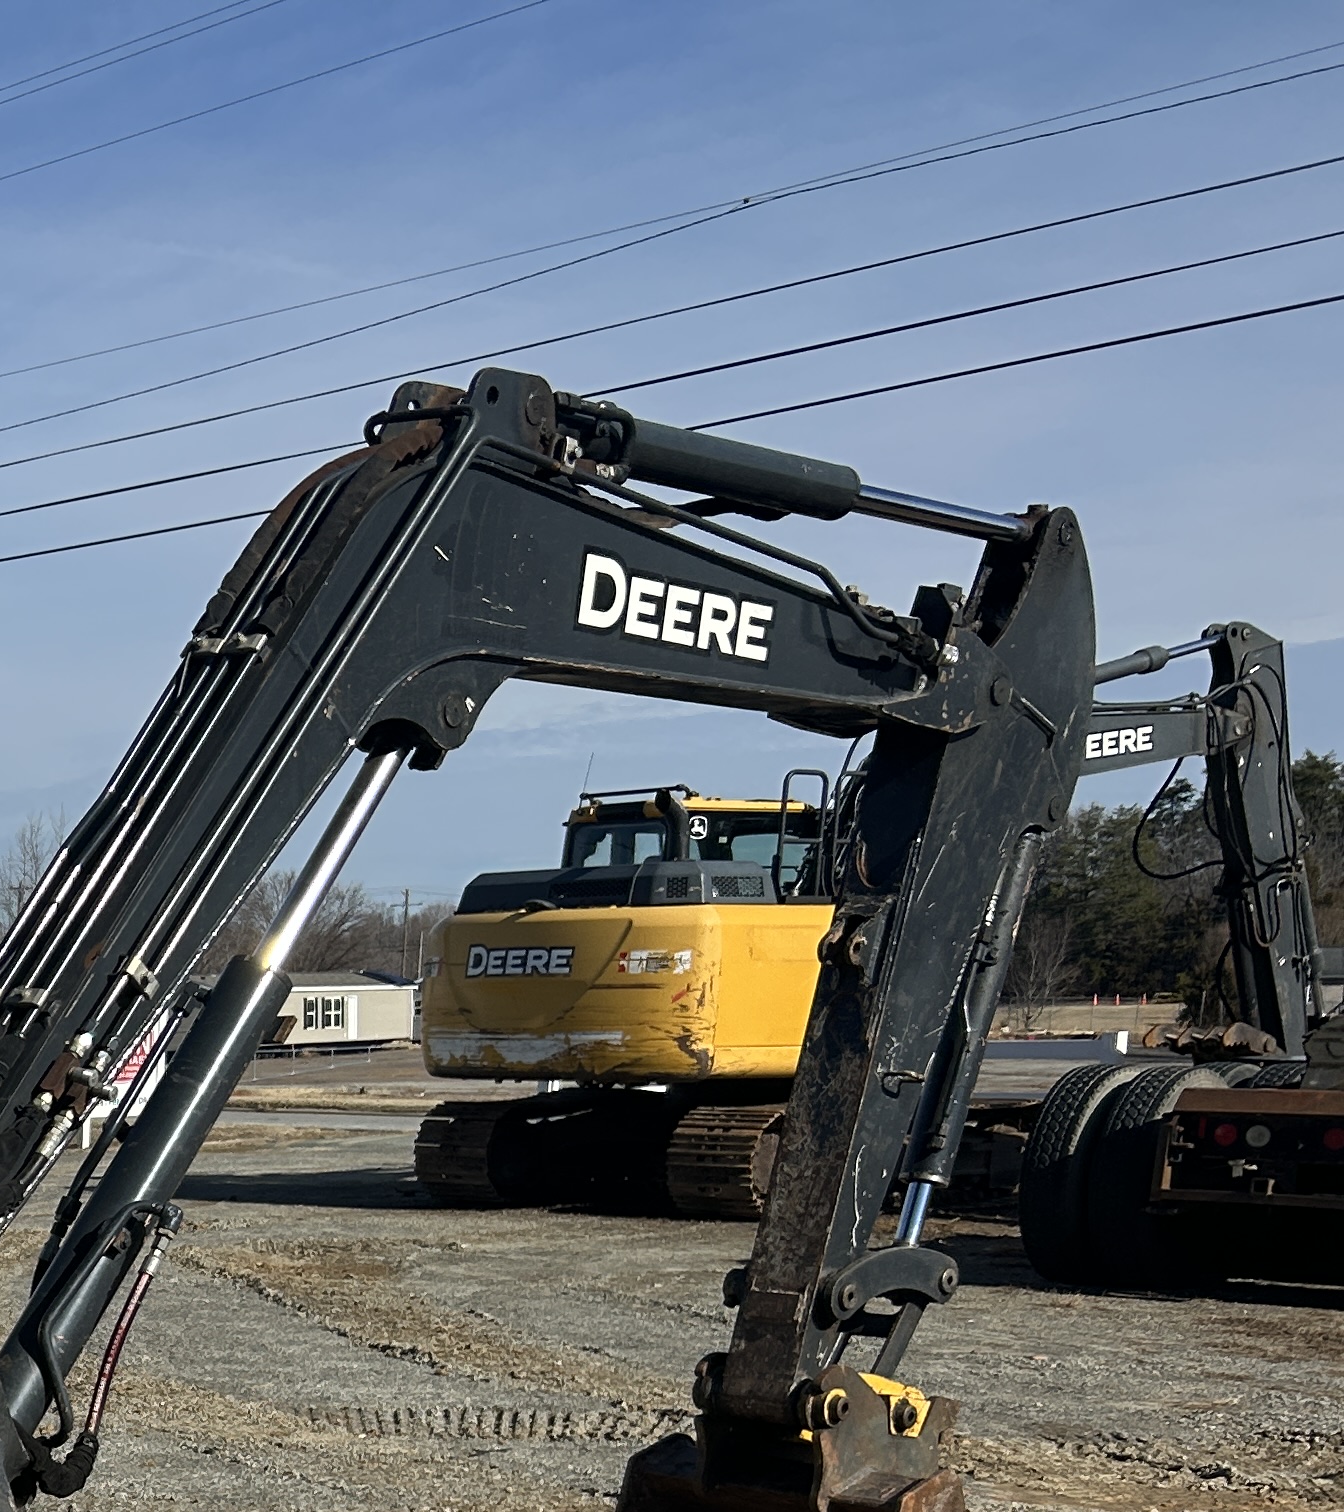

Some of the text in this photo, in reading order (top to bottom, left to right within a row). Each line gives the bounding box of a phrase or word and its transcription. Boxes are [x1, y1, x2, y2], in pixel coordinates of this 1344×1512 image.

[577, 553, 773, 662] DEERE
[1085, 725, 1153, 759] EERE
[466, 945, 574, 977] DEERE
